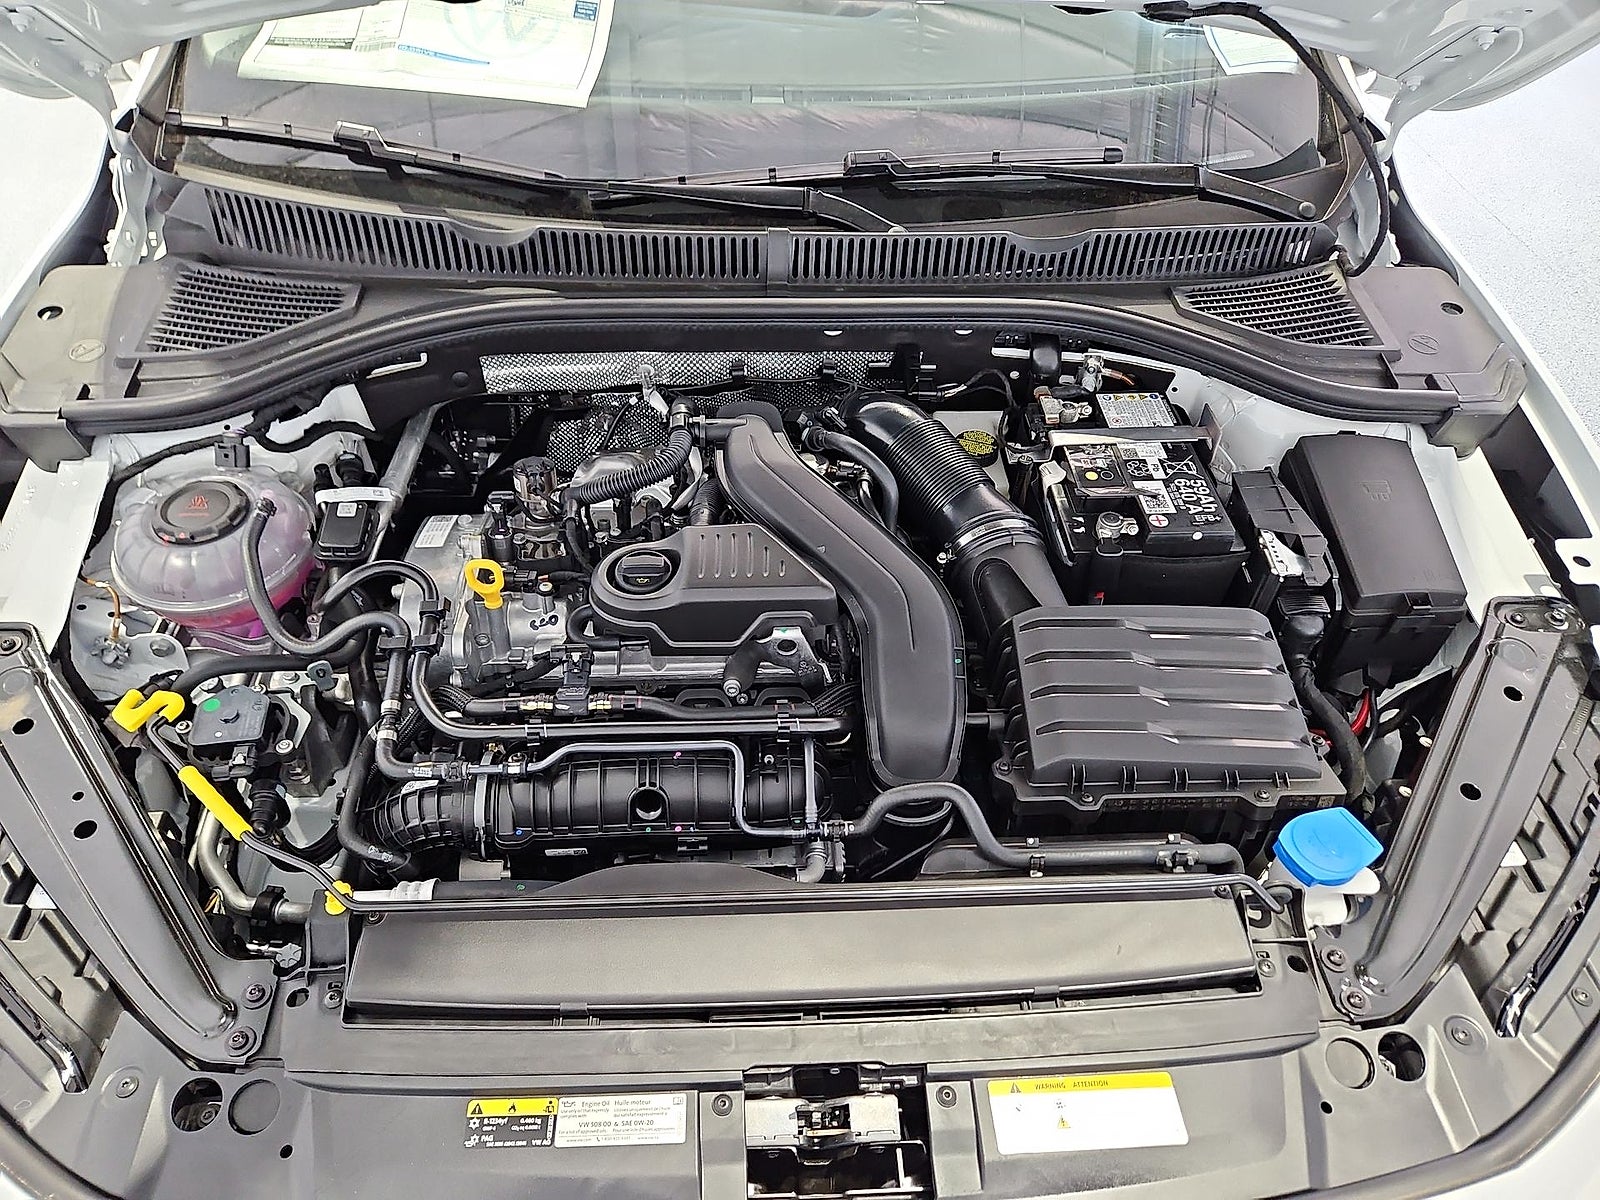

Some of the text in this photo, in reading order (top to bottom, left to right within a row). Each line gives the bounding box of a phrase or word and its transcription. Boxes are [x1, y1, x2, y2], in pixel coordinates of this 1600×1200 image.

[1150, 463, 1160, 473] Pb
[1174, 478, 1198, 501] 640
[1190, 479, 1218, 513] 59Ah
[1185, 503, 1204, 514] A
[1034, 1079, 1109, 1090] WARNING ATTENTION
[581, 1100, 600, 1108] Engine
